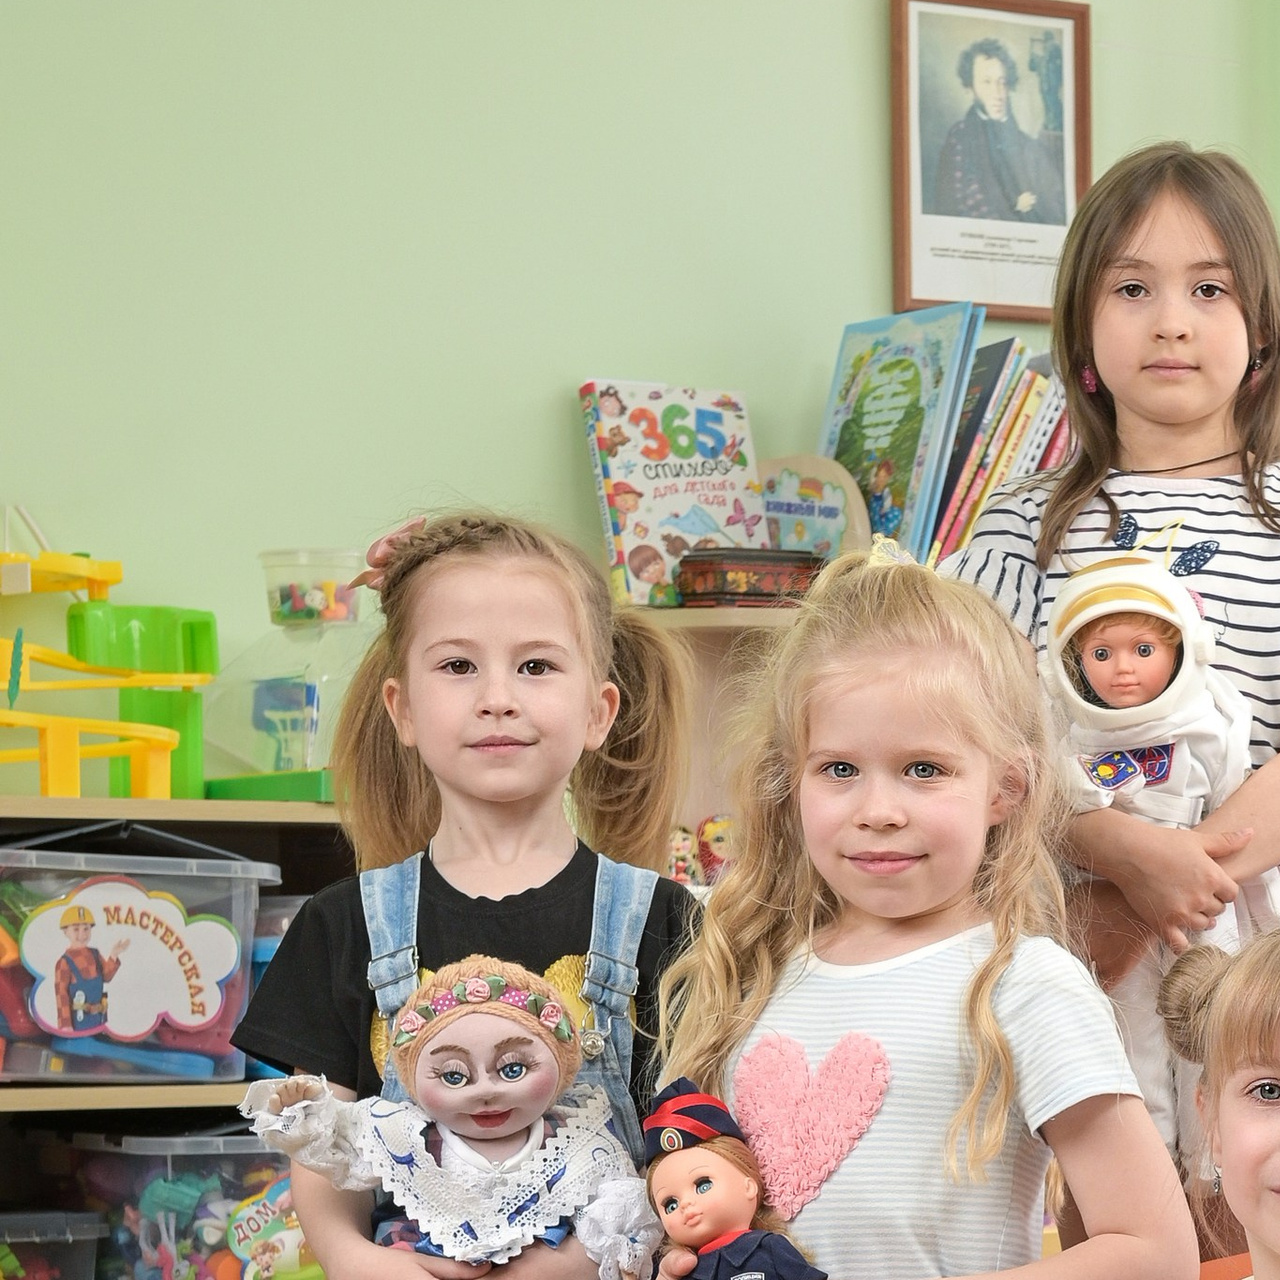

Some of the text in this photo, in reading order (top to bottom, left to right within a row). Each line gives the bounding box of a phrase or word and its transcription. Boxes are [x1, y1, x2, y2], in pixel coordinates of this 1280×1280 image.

[628, 403, 727, 462] 365
[103, 904, 207, 1017] МАСТЕРСКАЯ
[234, 1202, 278, 1247] ДОМ
